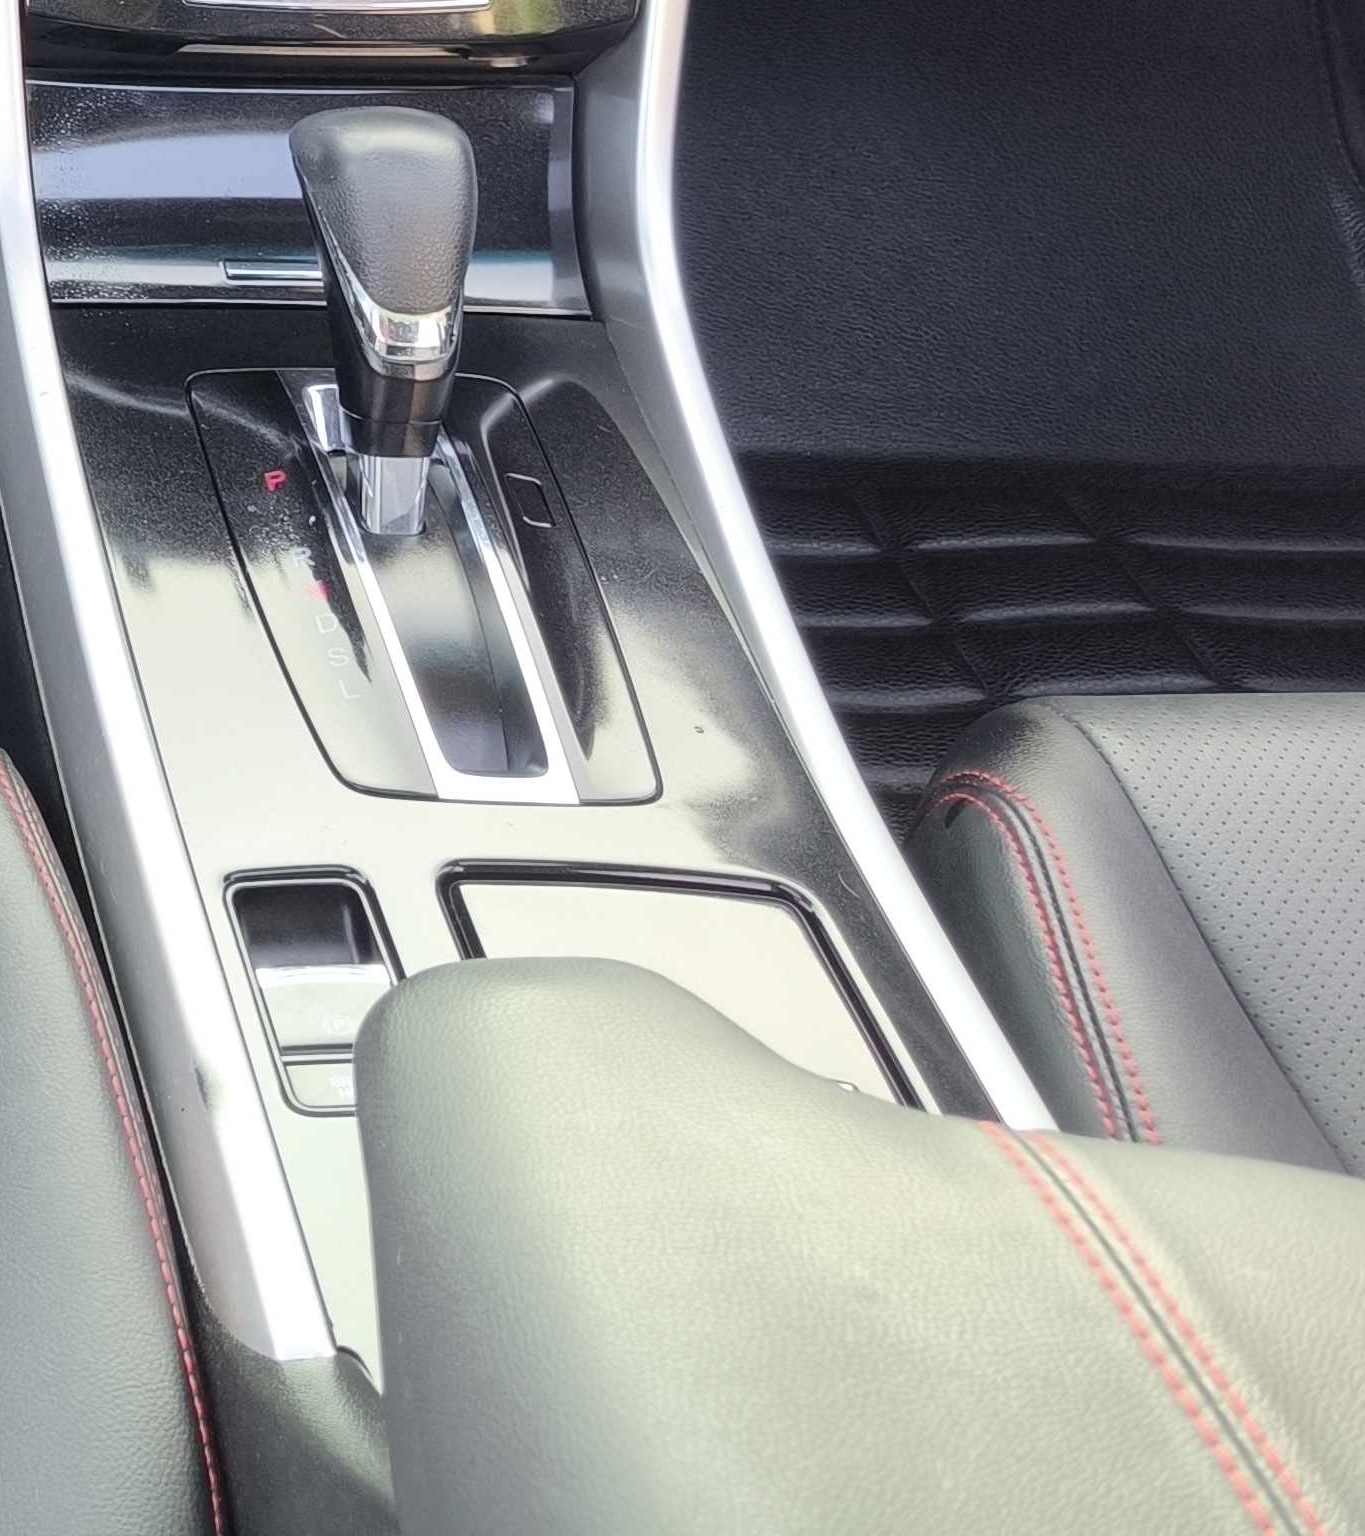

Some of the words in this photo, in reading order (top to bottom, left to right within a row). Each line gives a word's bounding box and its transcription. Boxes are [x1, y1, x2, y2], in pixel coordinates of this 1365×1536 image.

[264, 470, 286, 491] P
[291, 546, 316, 567] R
[302, 579, 328, 602] N
[314, 612, 339, 634] D
[327, 647, 350, 667] S
[339, 680, 361, 699] L
